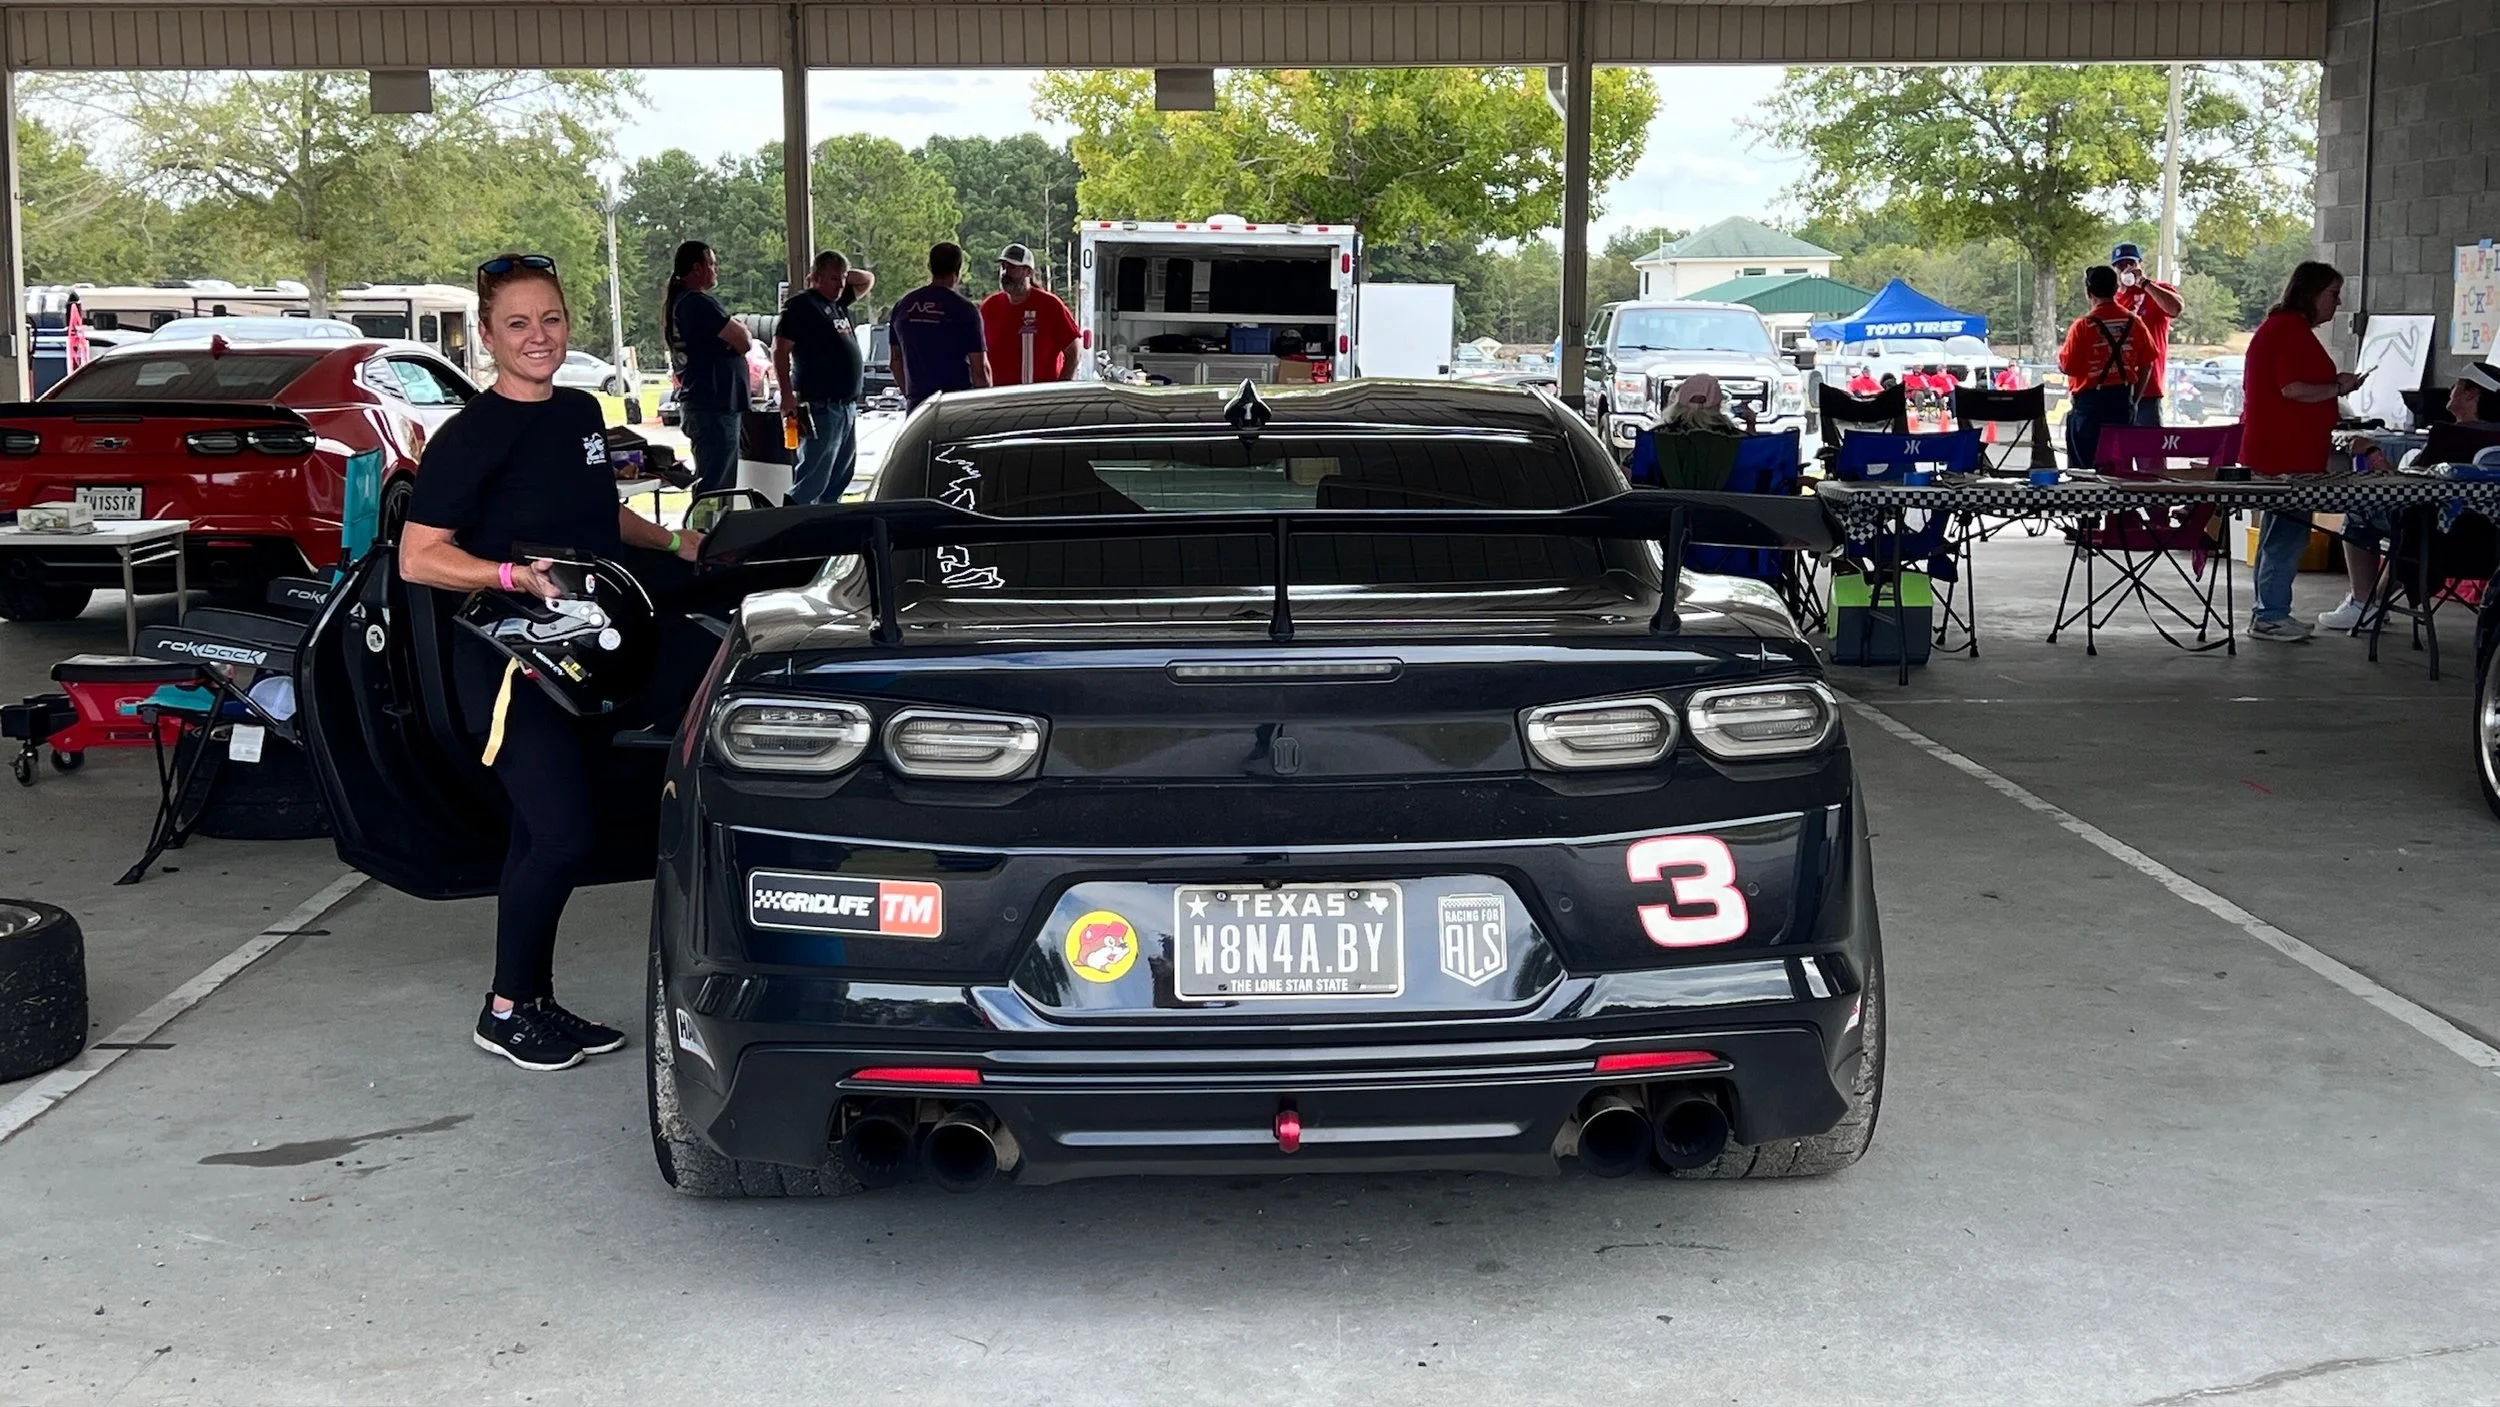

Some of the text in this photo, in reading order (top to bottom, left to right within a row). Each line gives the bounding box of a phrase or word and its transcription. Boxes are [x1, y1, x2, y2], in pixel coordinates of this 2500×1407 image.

[1865, 320, 1964, 337] TOYO TIRES
[2461, 322, 2496, 350] HER
[157, 640, 267, 665] rokback
[1626, 834, 1749, 948] 3
[780, 892, 935, 925] GRIDLIFE TM
[1230, 893, 1345, 918] TEXAS
[1445, 908, 1499, 922] RACING FOR
[1193, 923, 1384, 975] W8N4A.BY
[1446, 922, 1501, 980] ALS
[1230, 978, 1348, 992] THE LONE STAR STATE
[679, 1012, 697, 1042] HA
